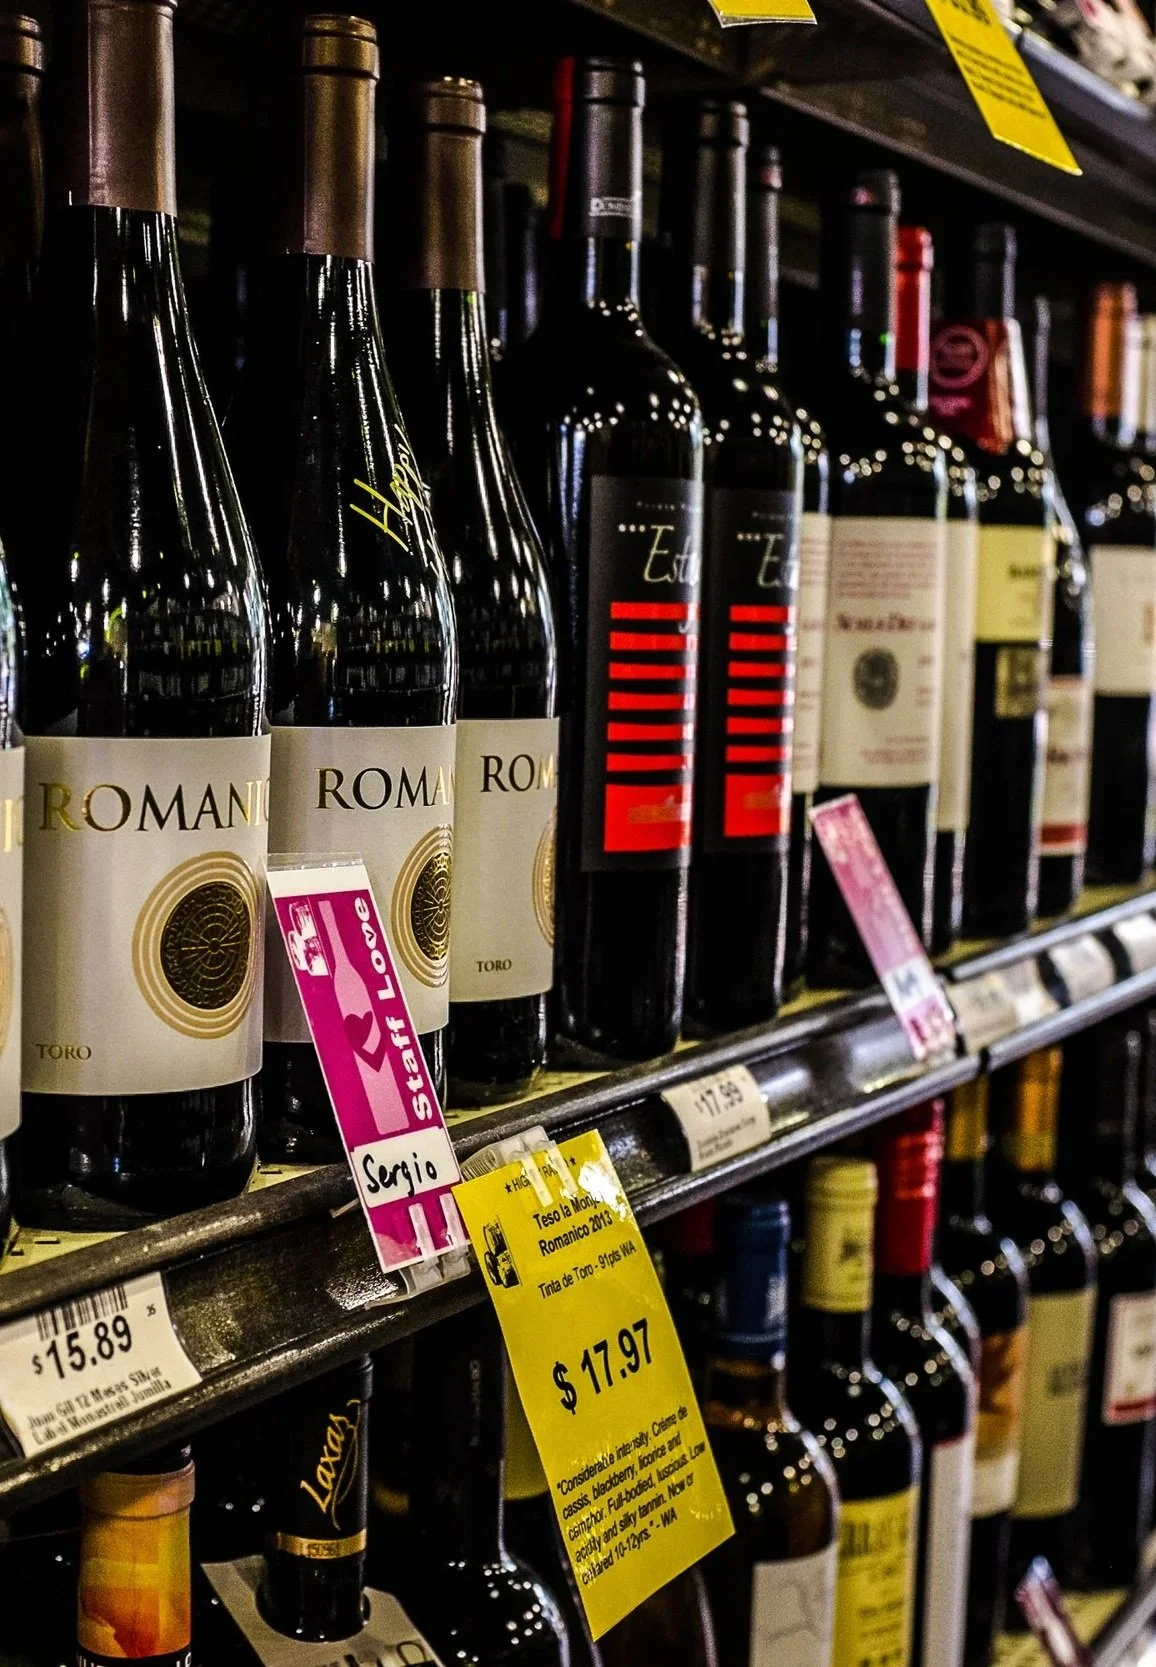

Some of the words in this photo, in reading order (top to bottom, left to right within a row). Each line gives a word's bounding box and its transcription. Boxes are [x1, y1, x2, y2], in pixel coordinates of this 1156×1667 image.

[354, 896, 396, 1001] Love
[476, 959, 512, 973] TORO
[35, 1043, 92, 1060] TORO
[385, 1016, 433, 1121] Staff
[362, 1152, 438, 1197] Sergio
[533, 1209, 561, 1230] Teso
[559, 1203, 573, 1219] la
[538, 1224, 590, 1257] Romanico
[588, 1209, 614, 1233] 2013
[537, 1279, 562, 1299] Tinta
[561, 1273, 574, 1288] de
[572, 1263, 594, 1280] Toro
[598, 1249, 622, 1270] 91pts
[619, 1240, 637, 1258] WA
[31, 1314, 133, 1380] $15.89
[552, 1360, 578, 1415] $
[580, 1317, 652, 1395] 17.97
[677, 1405, 688, 1421] de
[667, 1430, 682, 1453] and
[602, 1520, 618, 1544] and
[619, 1510, 637, 1532] silky
[667, 1479, 686, 1500] Now
[660, 1506, 678, 1529] WA
